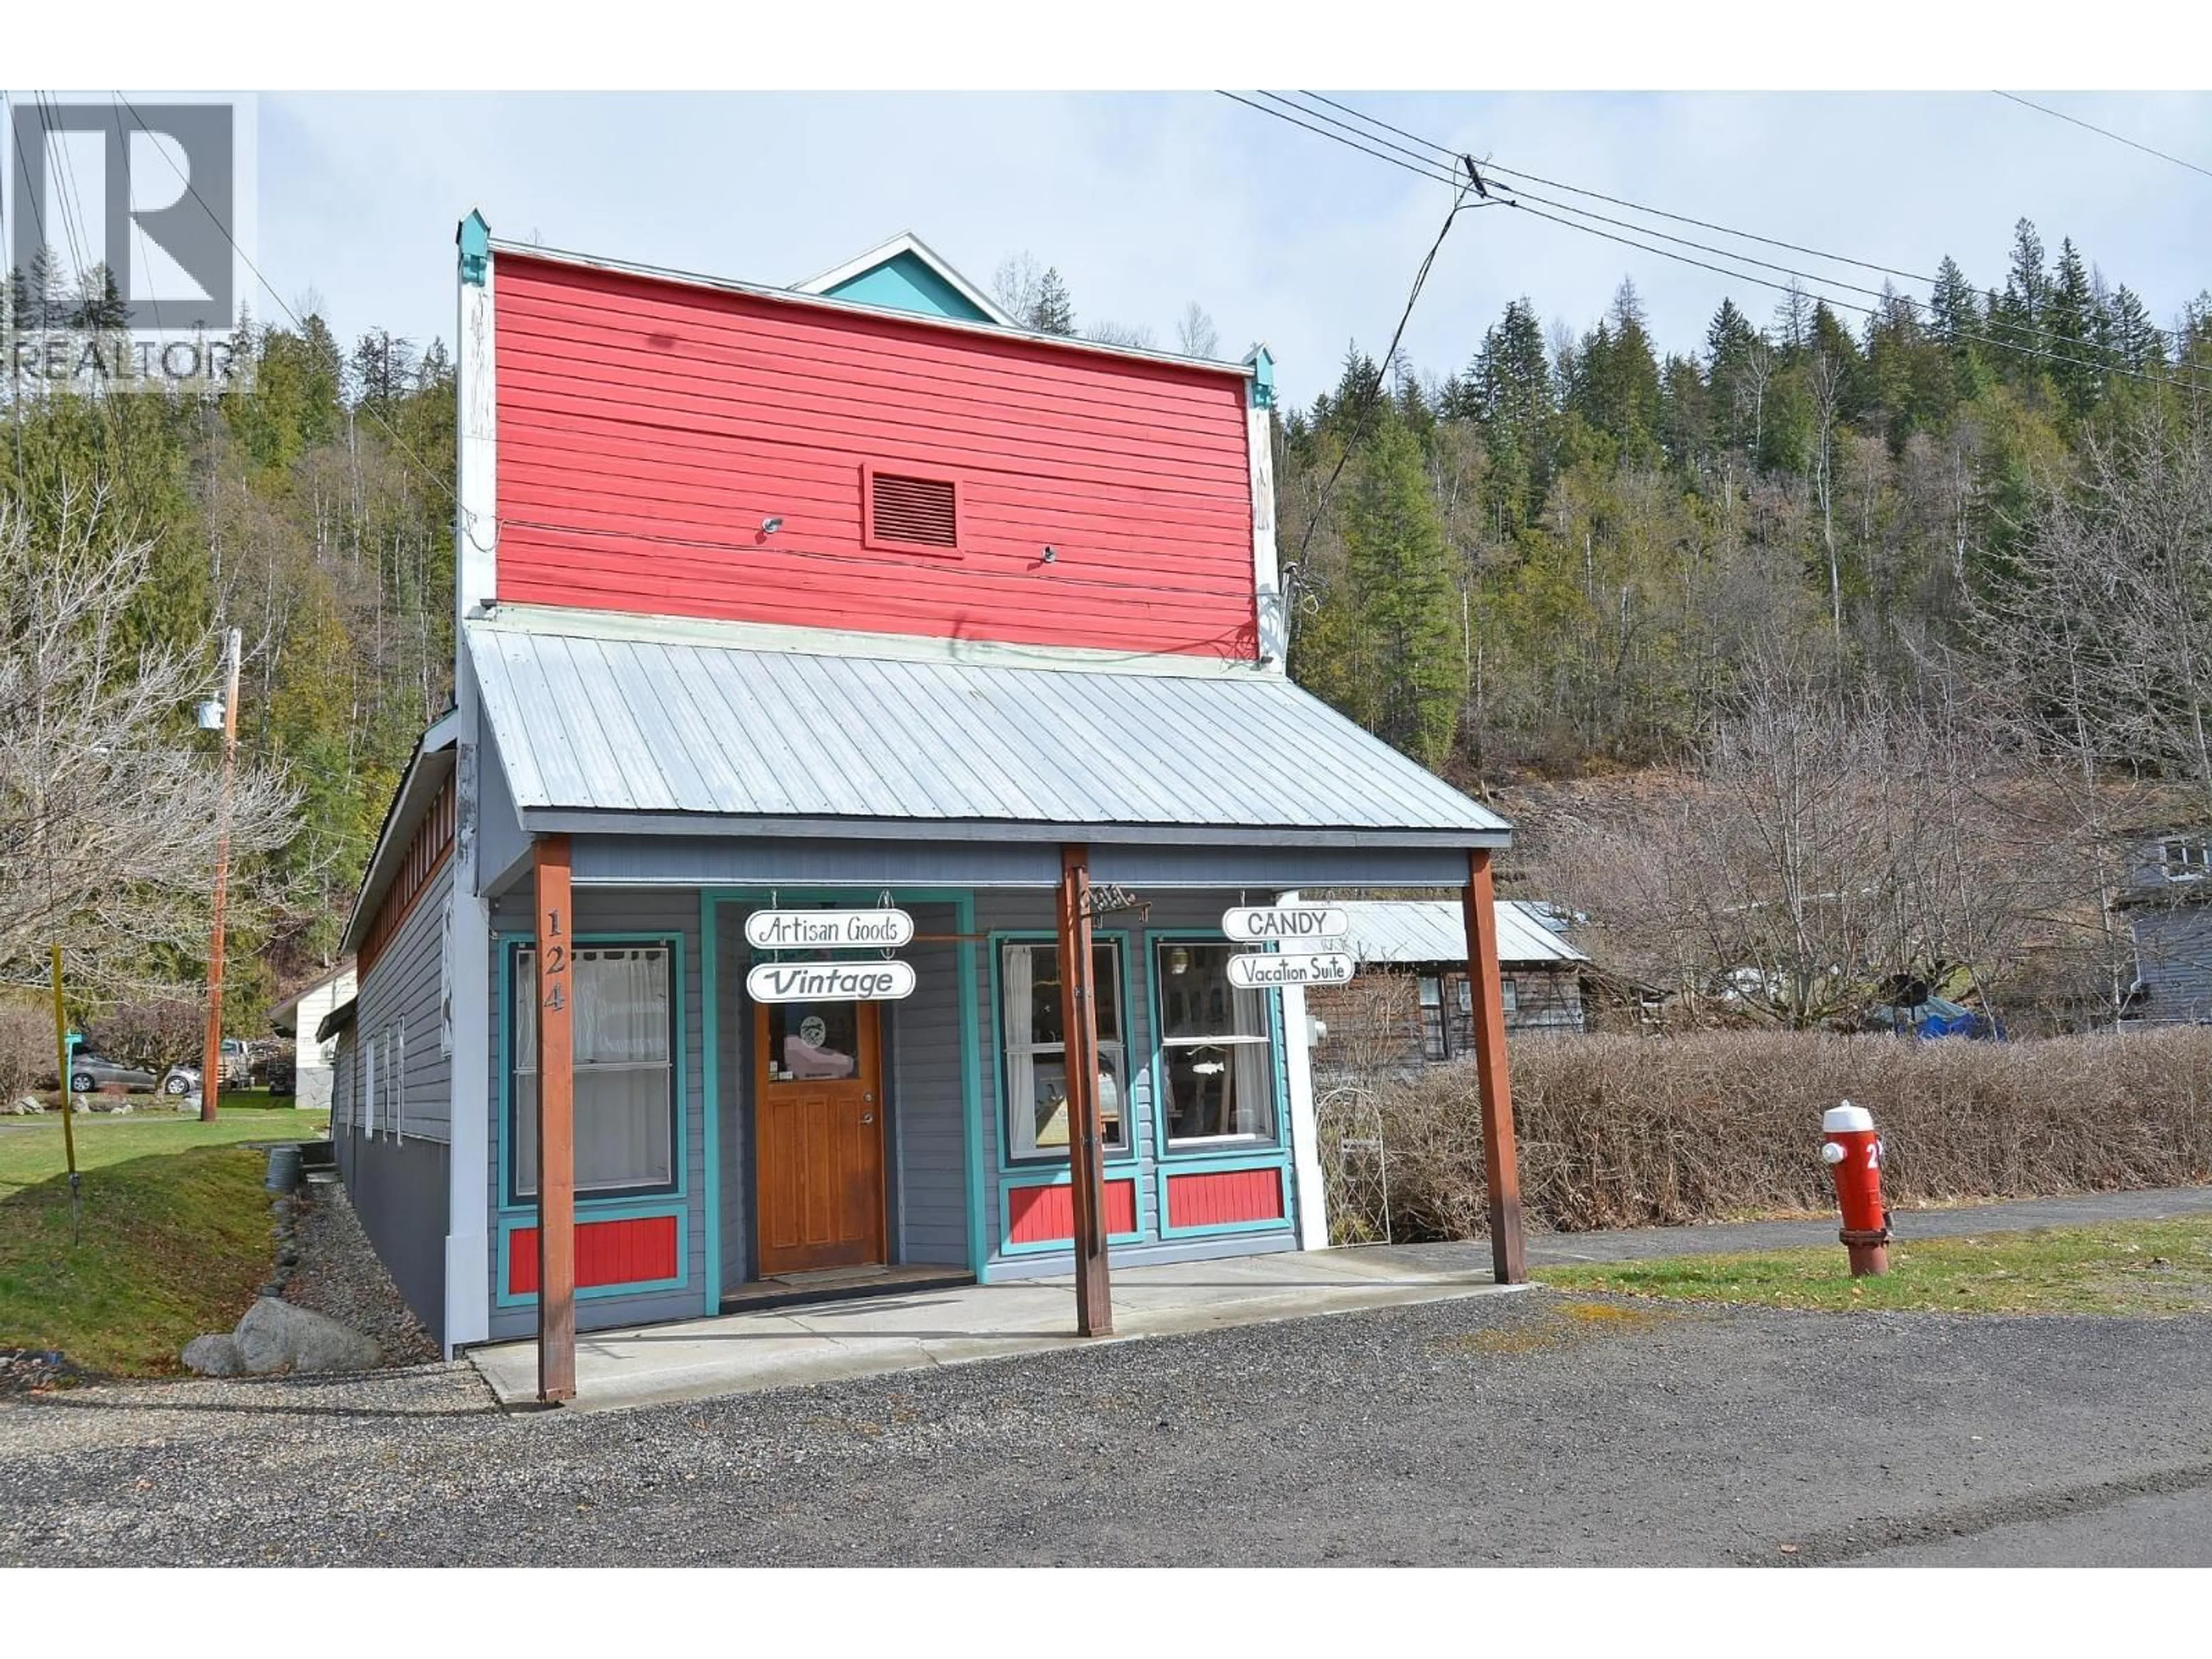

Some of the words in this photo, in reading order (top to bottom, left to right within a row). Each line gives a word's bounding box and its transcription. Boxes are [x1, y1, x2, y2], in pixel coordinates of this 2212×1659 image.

[759, 916, 839, 942] Artisan
[847, 916, 898, 941] Goods
[1247, 911, 1327, 935] CANDY
[543, 908, 566, 1012] 124
[1241, 959, 1307, 983] Vacation
[1310, 956, 1344, 979] Suite
[763, 969, 893, 998] Vintage
